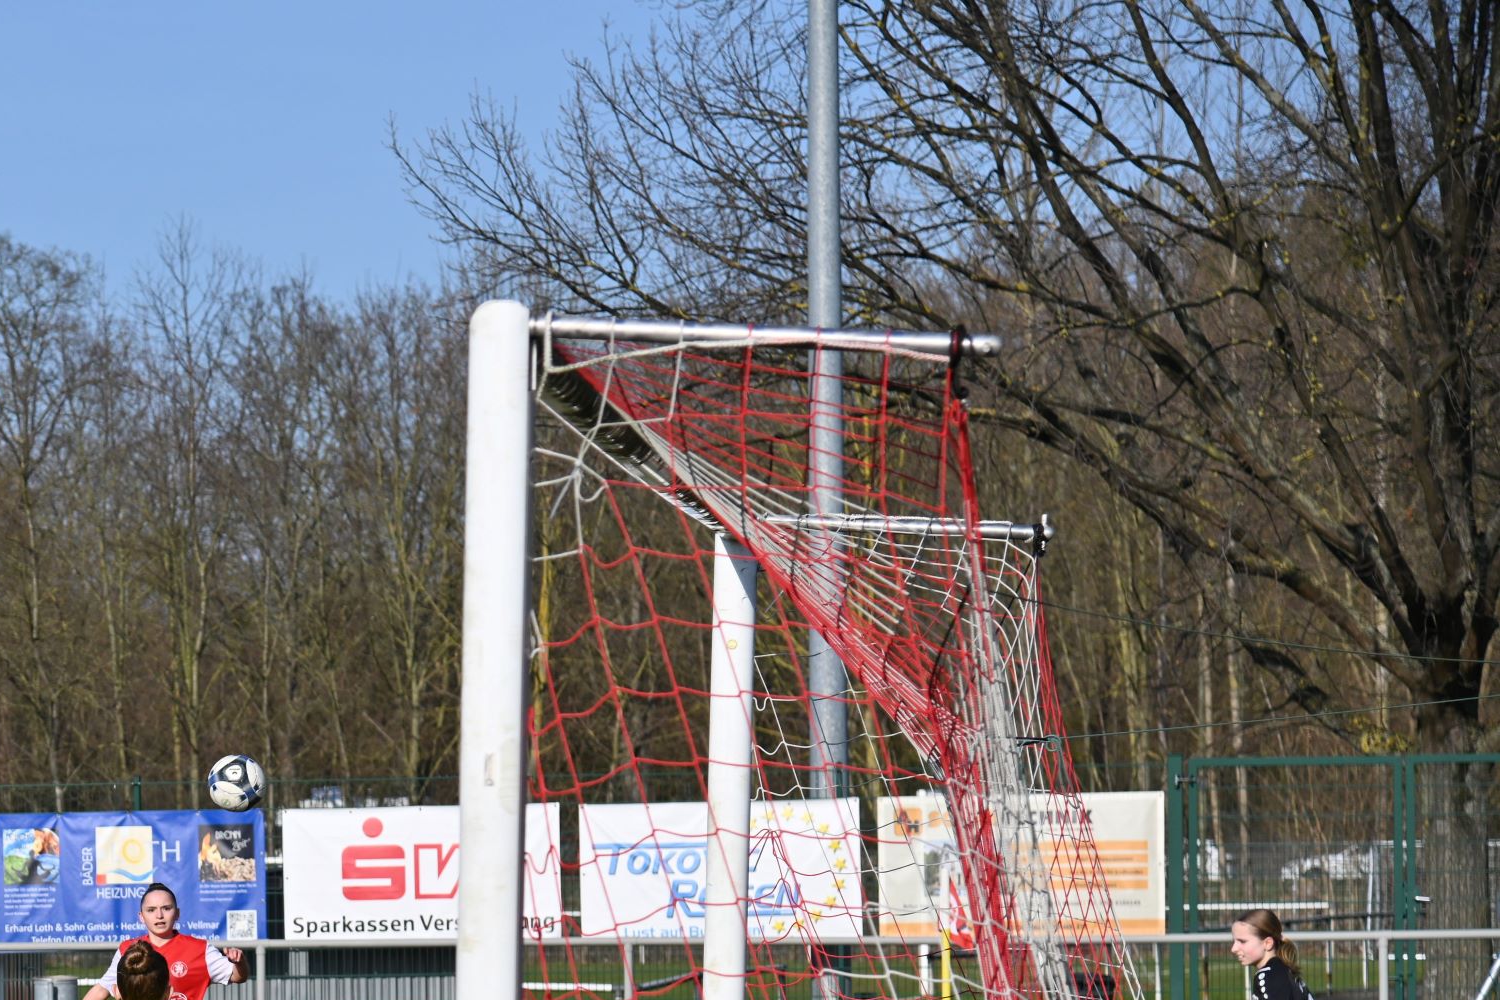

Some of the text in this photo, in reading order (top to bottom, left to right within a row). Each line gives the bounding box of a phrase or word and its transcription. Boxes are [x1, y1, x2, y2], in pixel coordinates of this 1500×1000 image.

[81, 847, 93, 886] BÄDER
[4, 923, 33, 933] Erhard
[35, 922, 54, 933] Loth
[64, 922, 86, 932] Sohn
[86, 922, 114, 931] GmbH
[187, 920, 220, 930] Vellmar
[293, 915, 414, 937] Sparkassen
